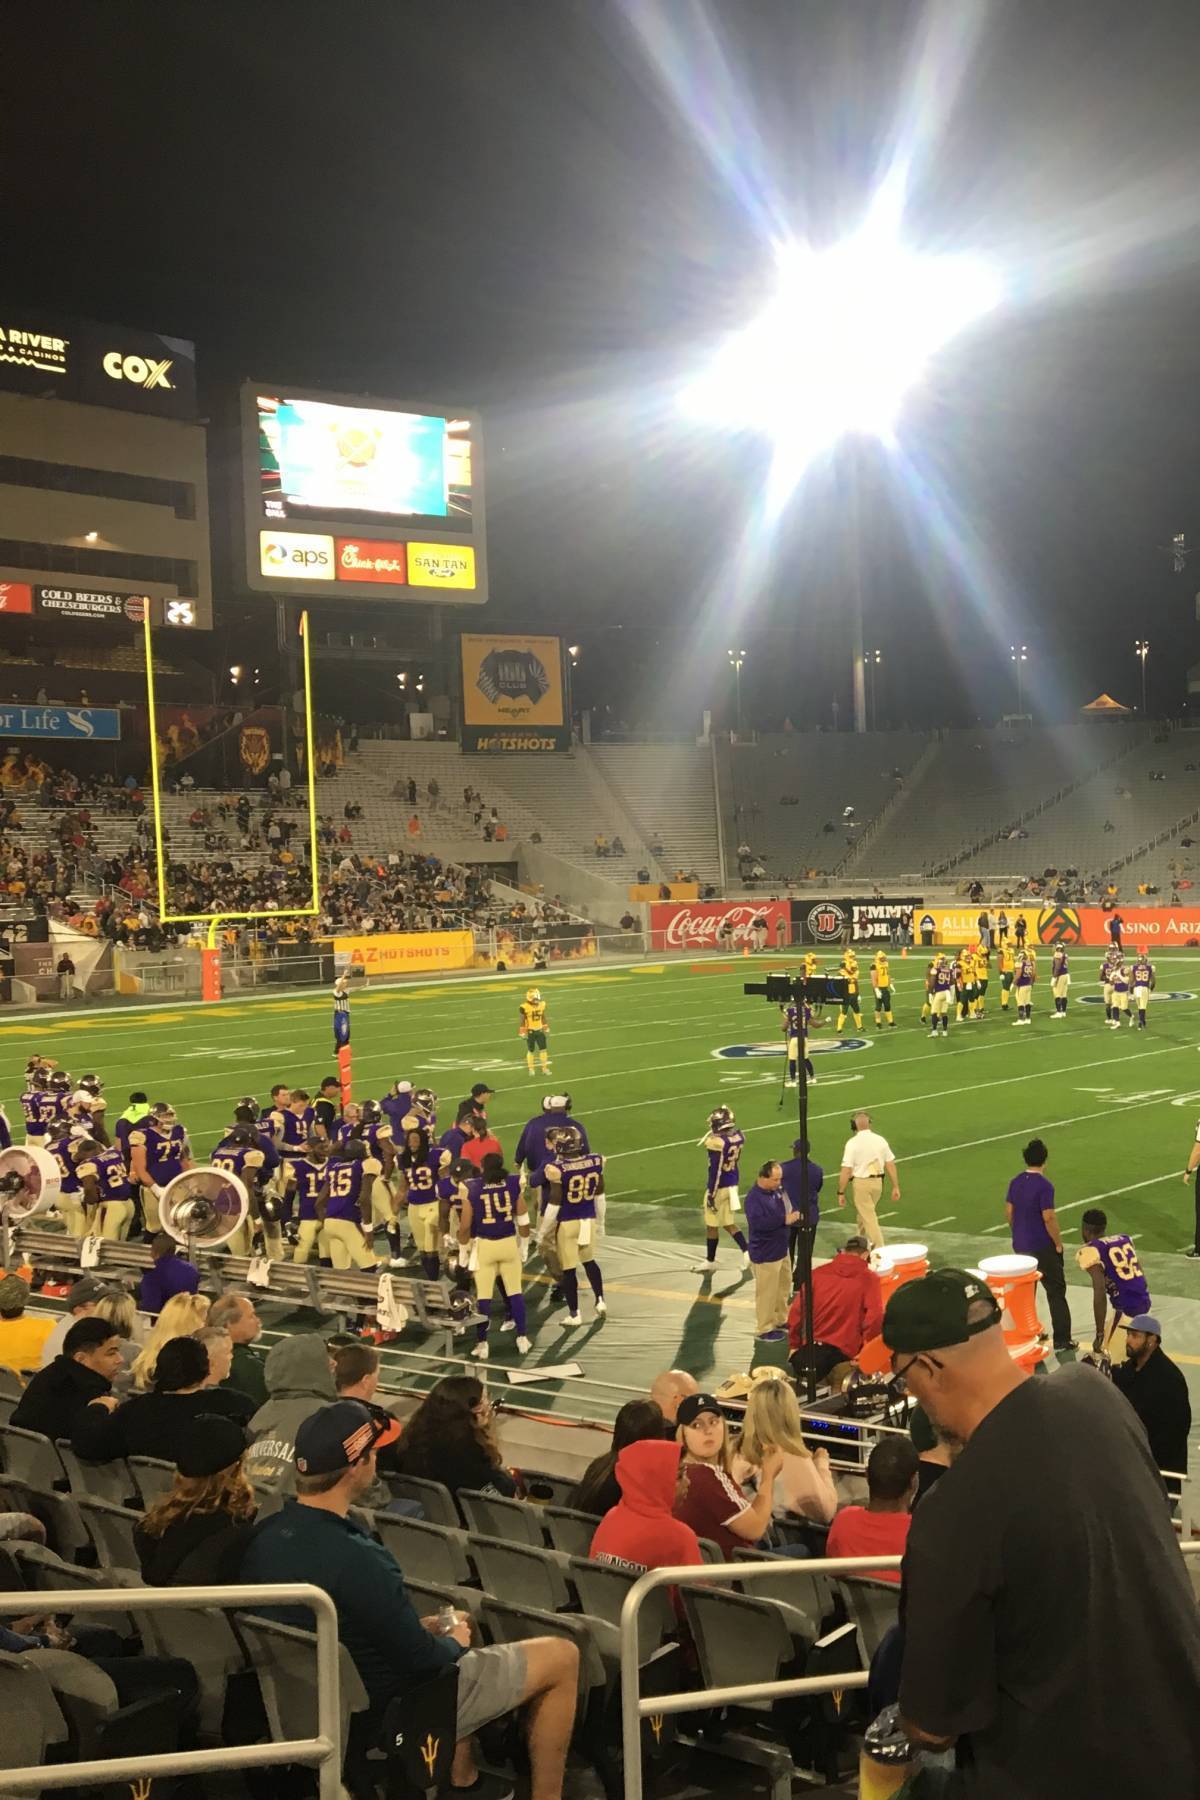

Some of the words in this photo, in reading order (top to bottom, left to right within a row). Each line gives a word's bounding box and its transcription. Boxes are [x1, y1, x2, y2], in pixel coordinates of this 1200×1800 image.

[9, 329, 65, 353] RIVER
[19, 348, 66, 362] CASINOS
[103, 352, 173, 389] COX
[292, 549, 328, 566] aps
[415, 556, 440, 567] SAN
[443, 560, 468, 569] TAN
[41, 589, 73, 601] COLD
[75, 592, 112, 604] BEERS
[41, 599, 122, 613] CHEESEBURGERS
[21, 709, 60, 729] Life
[567, 1171, 600, 1204] 80
[480, 1190, 513, 1224] 14
[1108, 1243, 1143, 1280] 82
